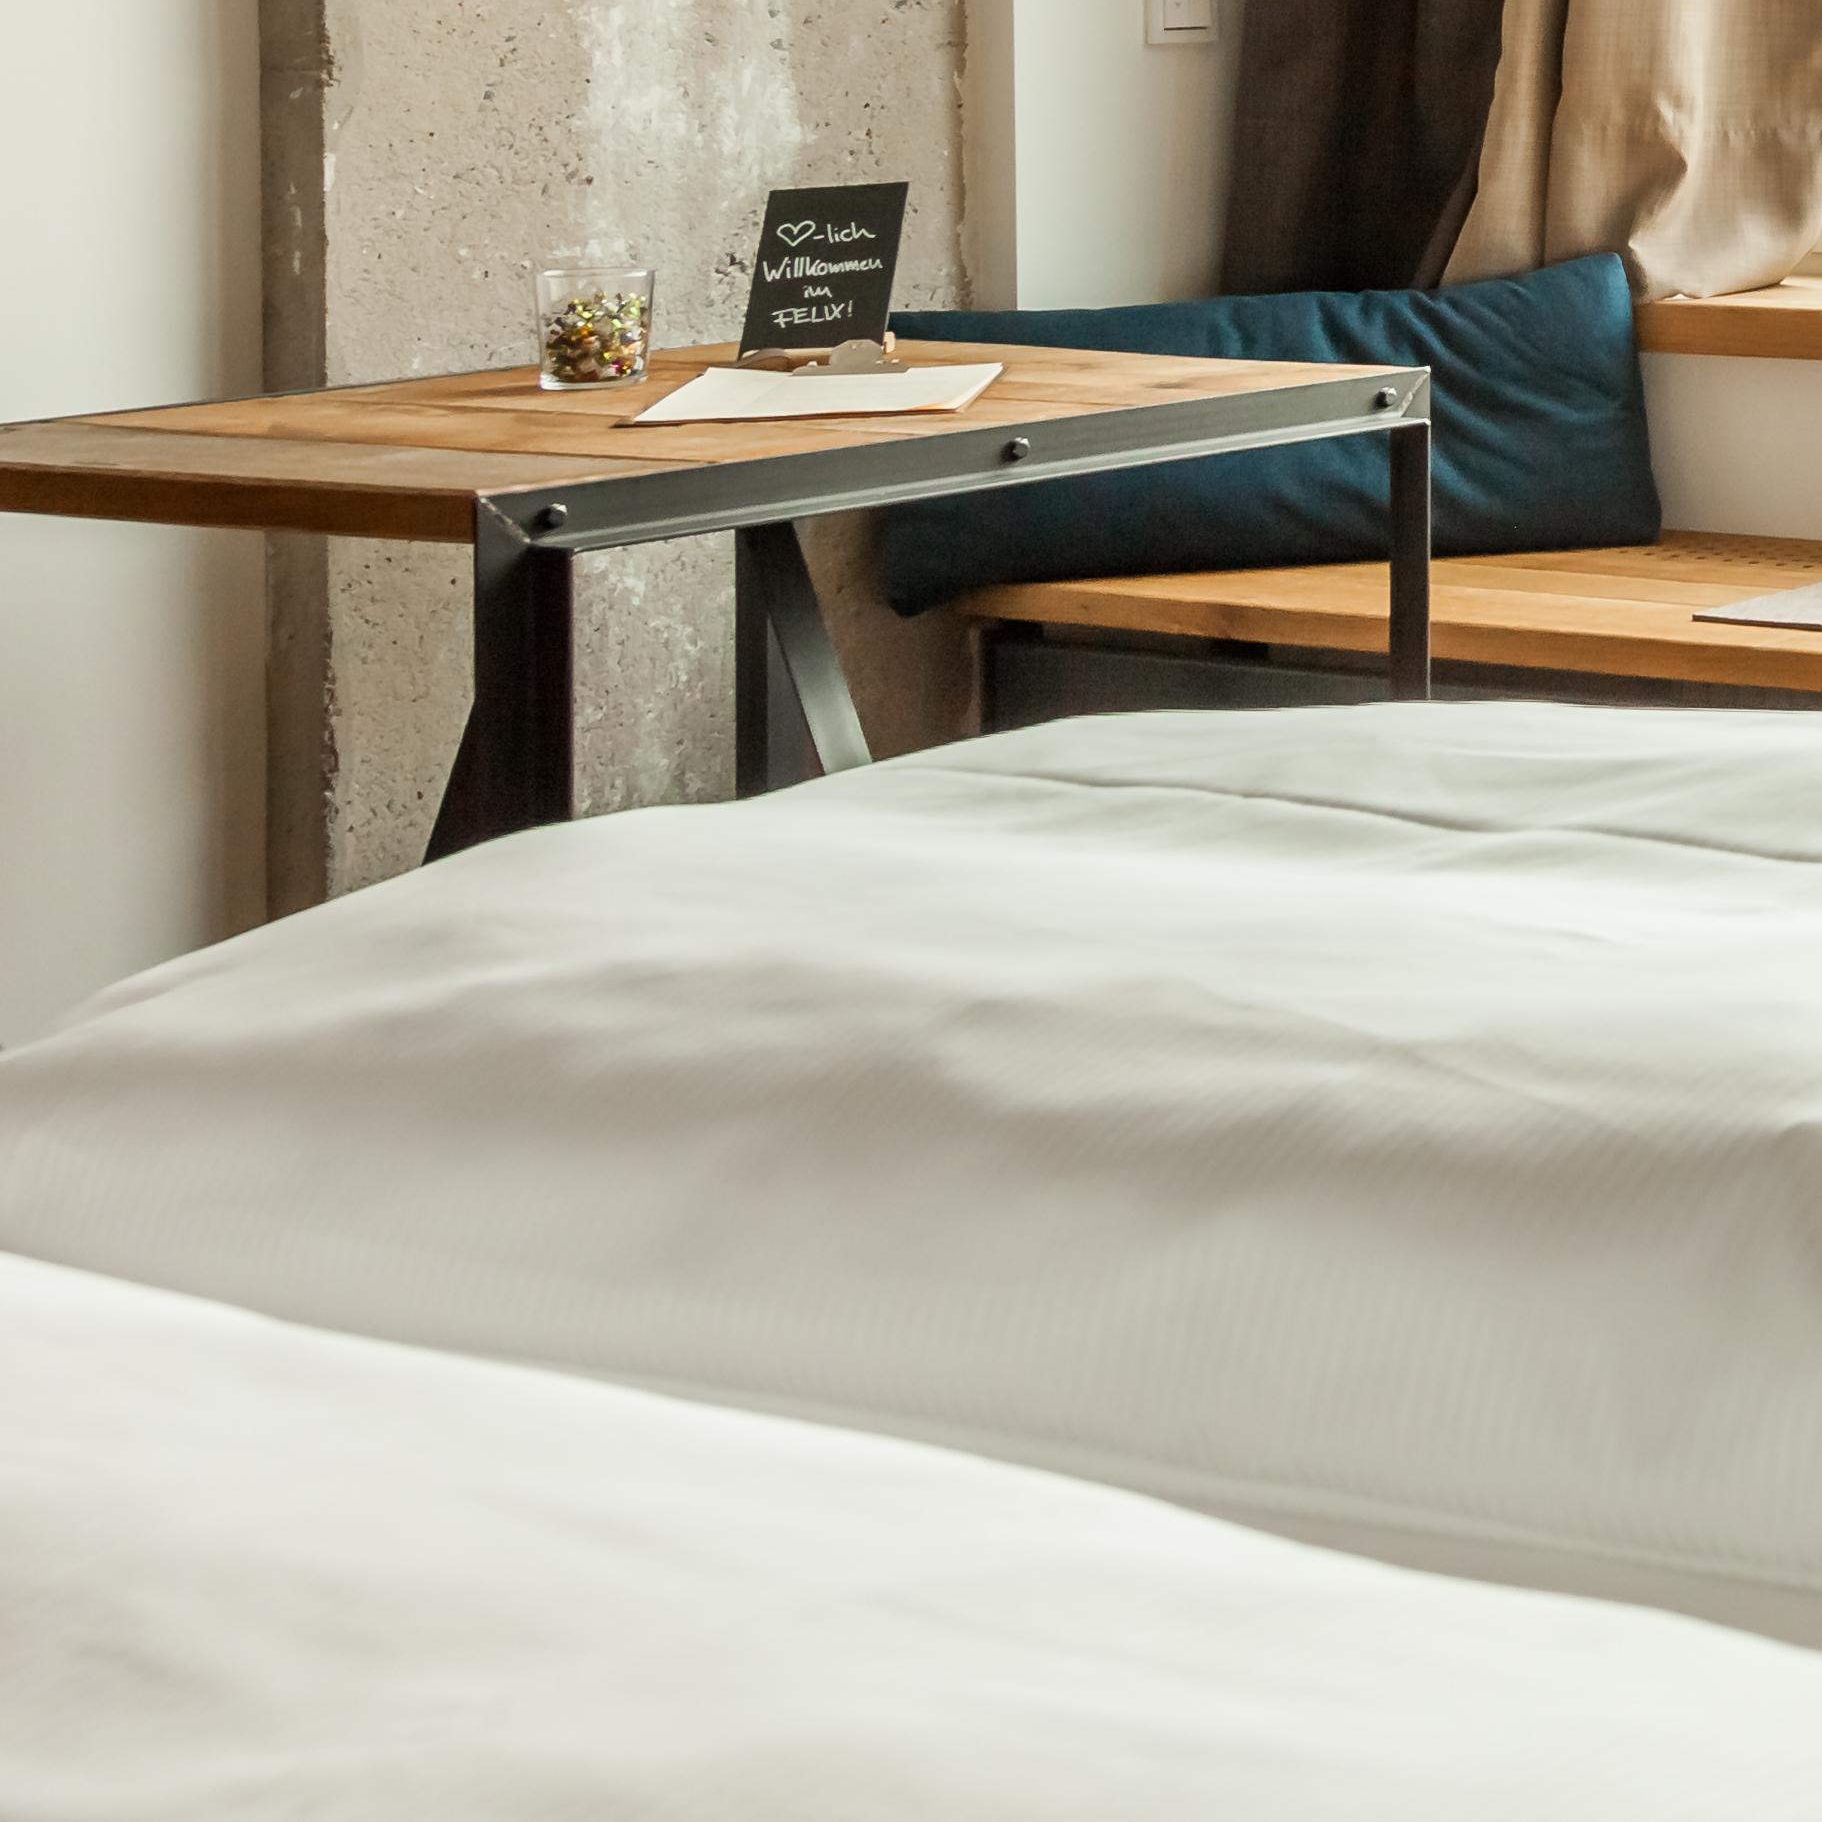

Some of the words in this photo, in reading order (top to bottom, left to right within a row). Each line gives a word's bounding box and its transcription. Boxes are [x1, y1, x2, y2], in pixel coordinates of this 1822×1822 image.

[763, 256, 883, 283] Willkommen
[803, 285, 833, 299] im
[770, 300, 853, 329] FELIX!
